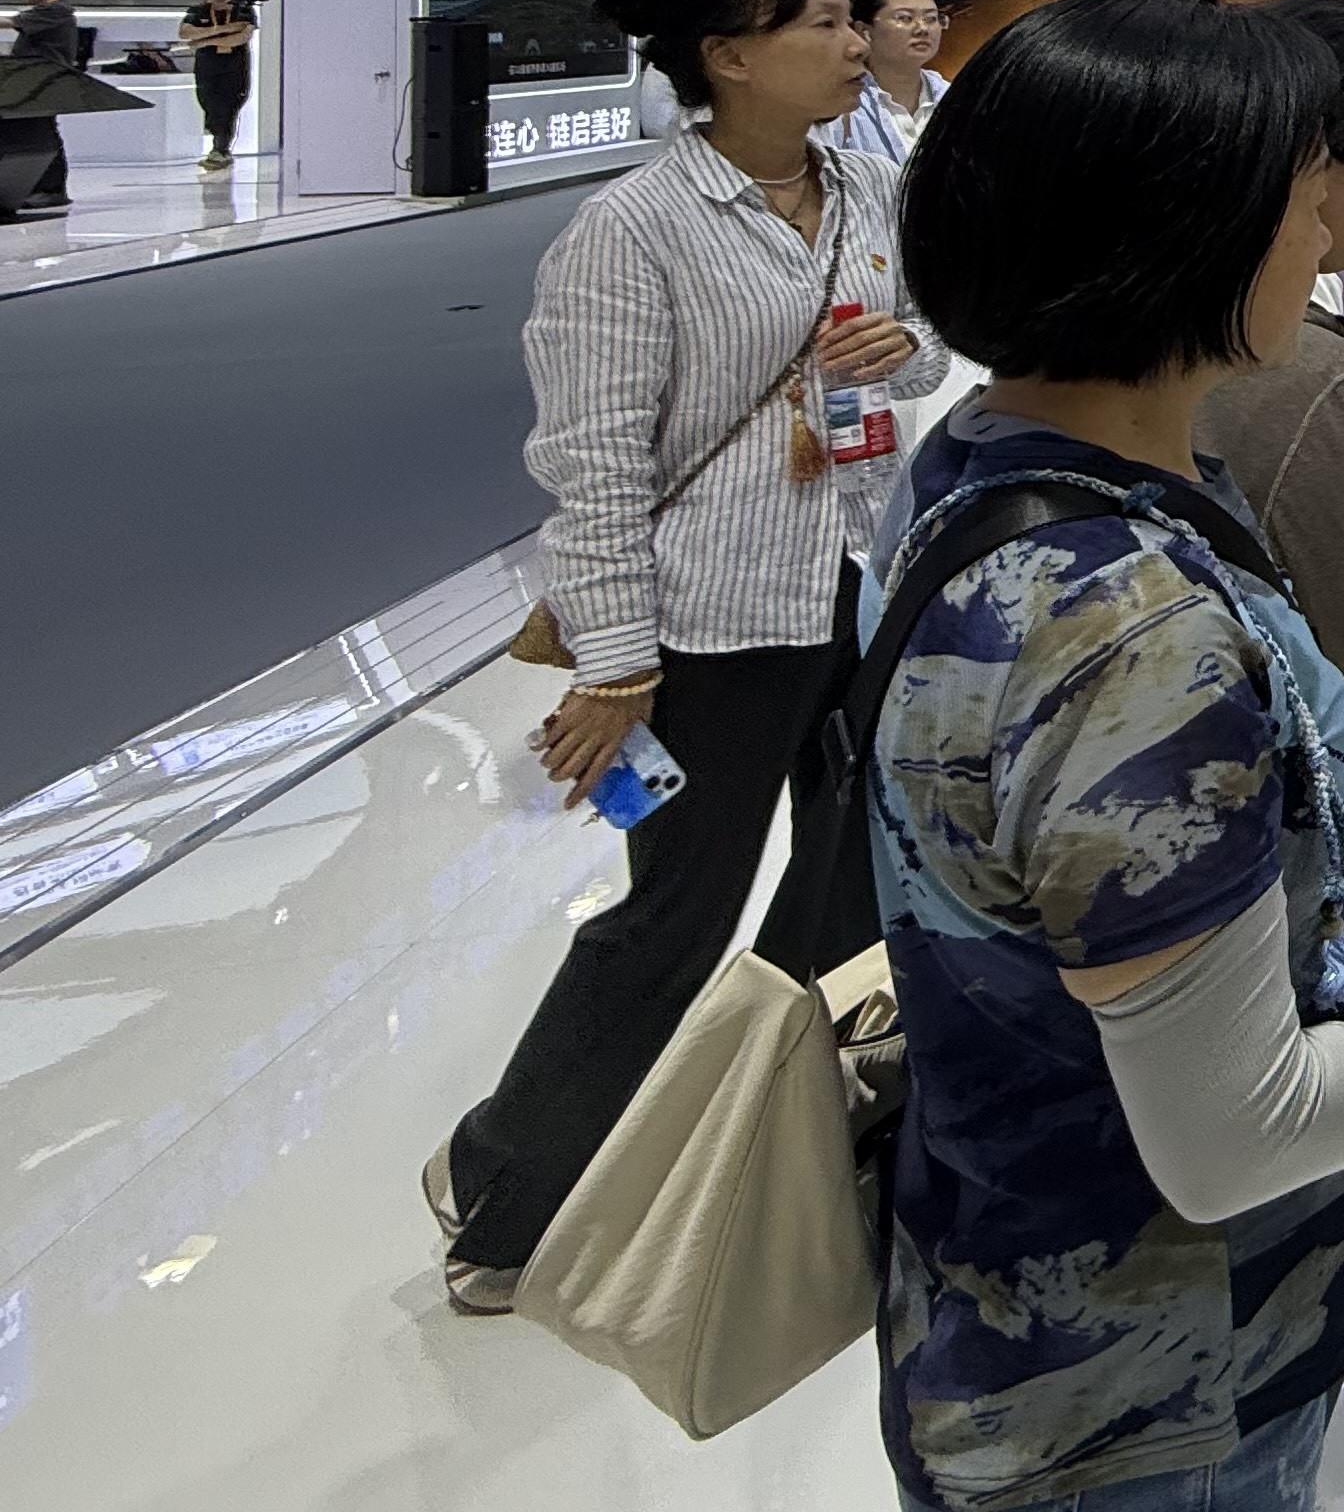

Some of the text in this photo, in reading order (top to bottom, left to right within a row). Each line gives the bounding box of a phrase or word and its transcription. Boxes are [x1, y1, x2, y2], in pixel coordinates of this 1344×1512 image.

[484, 105, 632, 157] 连心 链启美好
